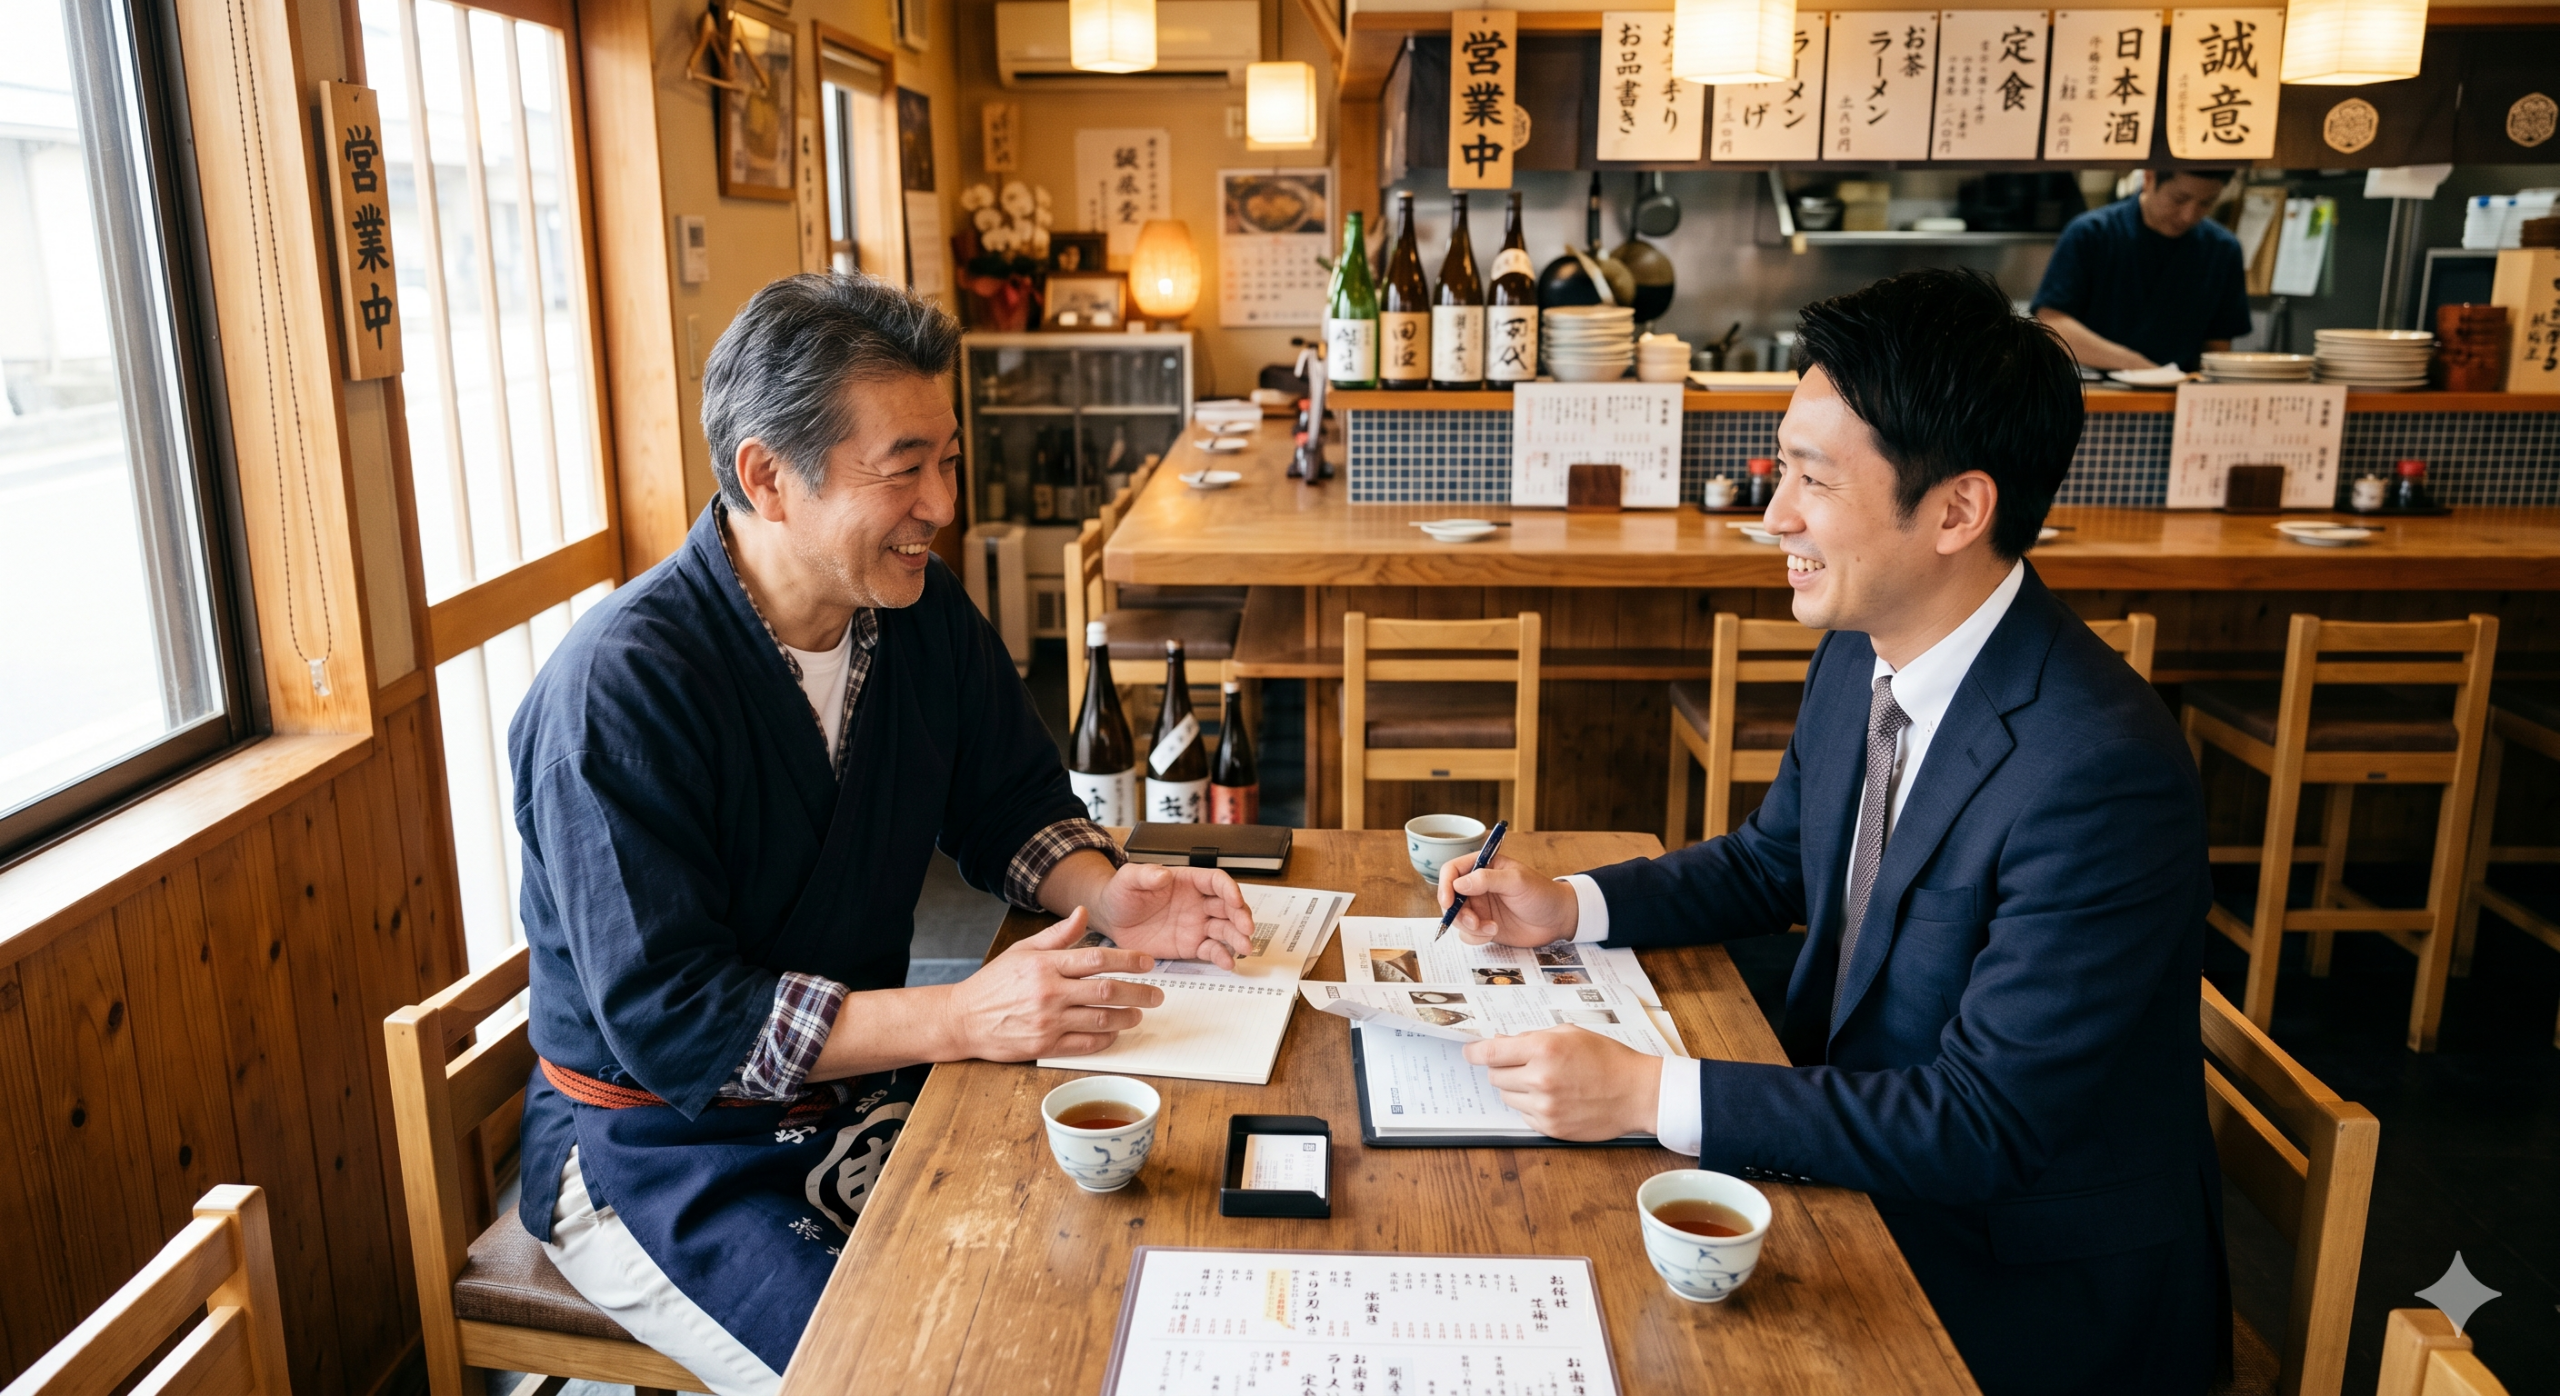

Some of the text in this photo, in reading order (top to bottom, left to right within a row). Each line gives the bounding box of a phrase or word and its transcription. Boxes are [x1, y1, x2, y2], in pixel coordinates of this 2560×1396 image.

[1461, 31, 1508, 179] 営業中
[1615, 23, 1642, 134] お品書き
[1866, 30, 1892, 125] ラーメン
[1900, 25, 1926, 78] お茶
[1995, 25, 2036, 112] 定食
[2104, 27, 2147, 145] 日本酒
[2197, 20, 2258, 144] 誠意
[344, 125, 394, 350] 営業中
